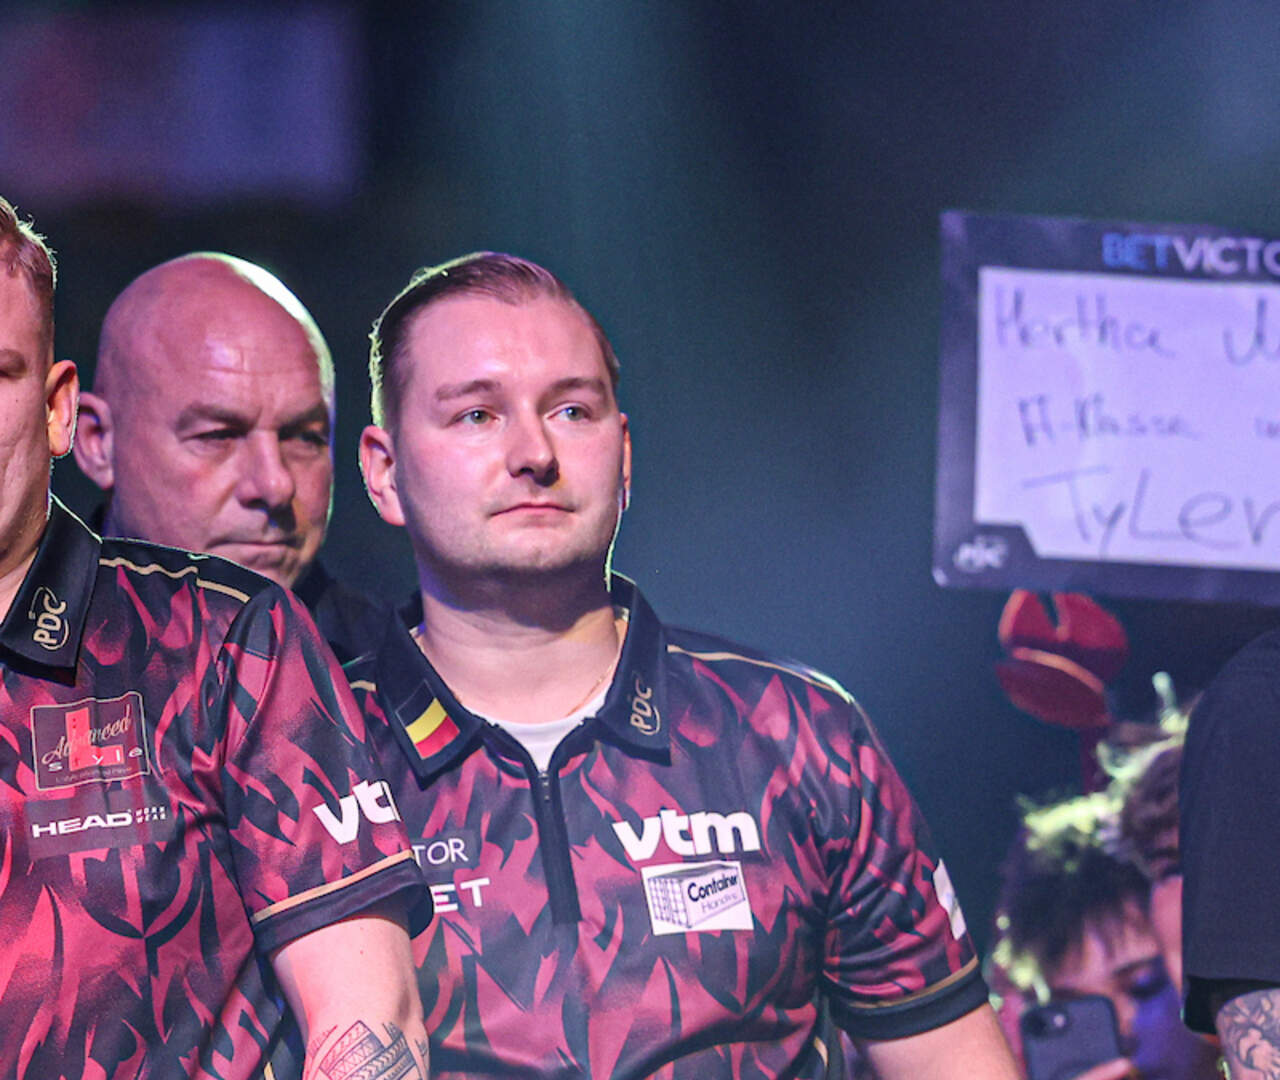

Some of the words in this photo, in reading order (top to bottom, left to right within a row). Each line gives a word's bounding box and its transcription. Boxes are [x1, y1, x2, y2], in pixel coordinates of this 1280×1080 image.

[33, 593, 66, 644] PDC
[32, 812, 133, 839] HEAD
[312, 780, 401, 845] vt
[612, 809, 761, 861] vtm
